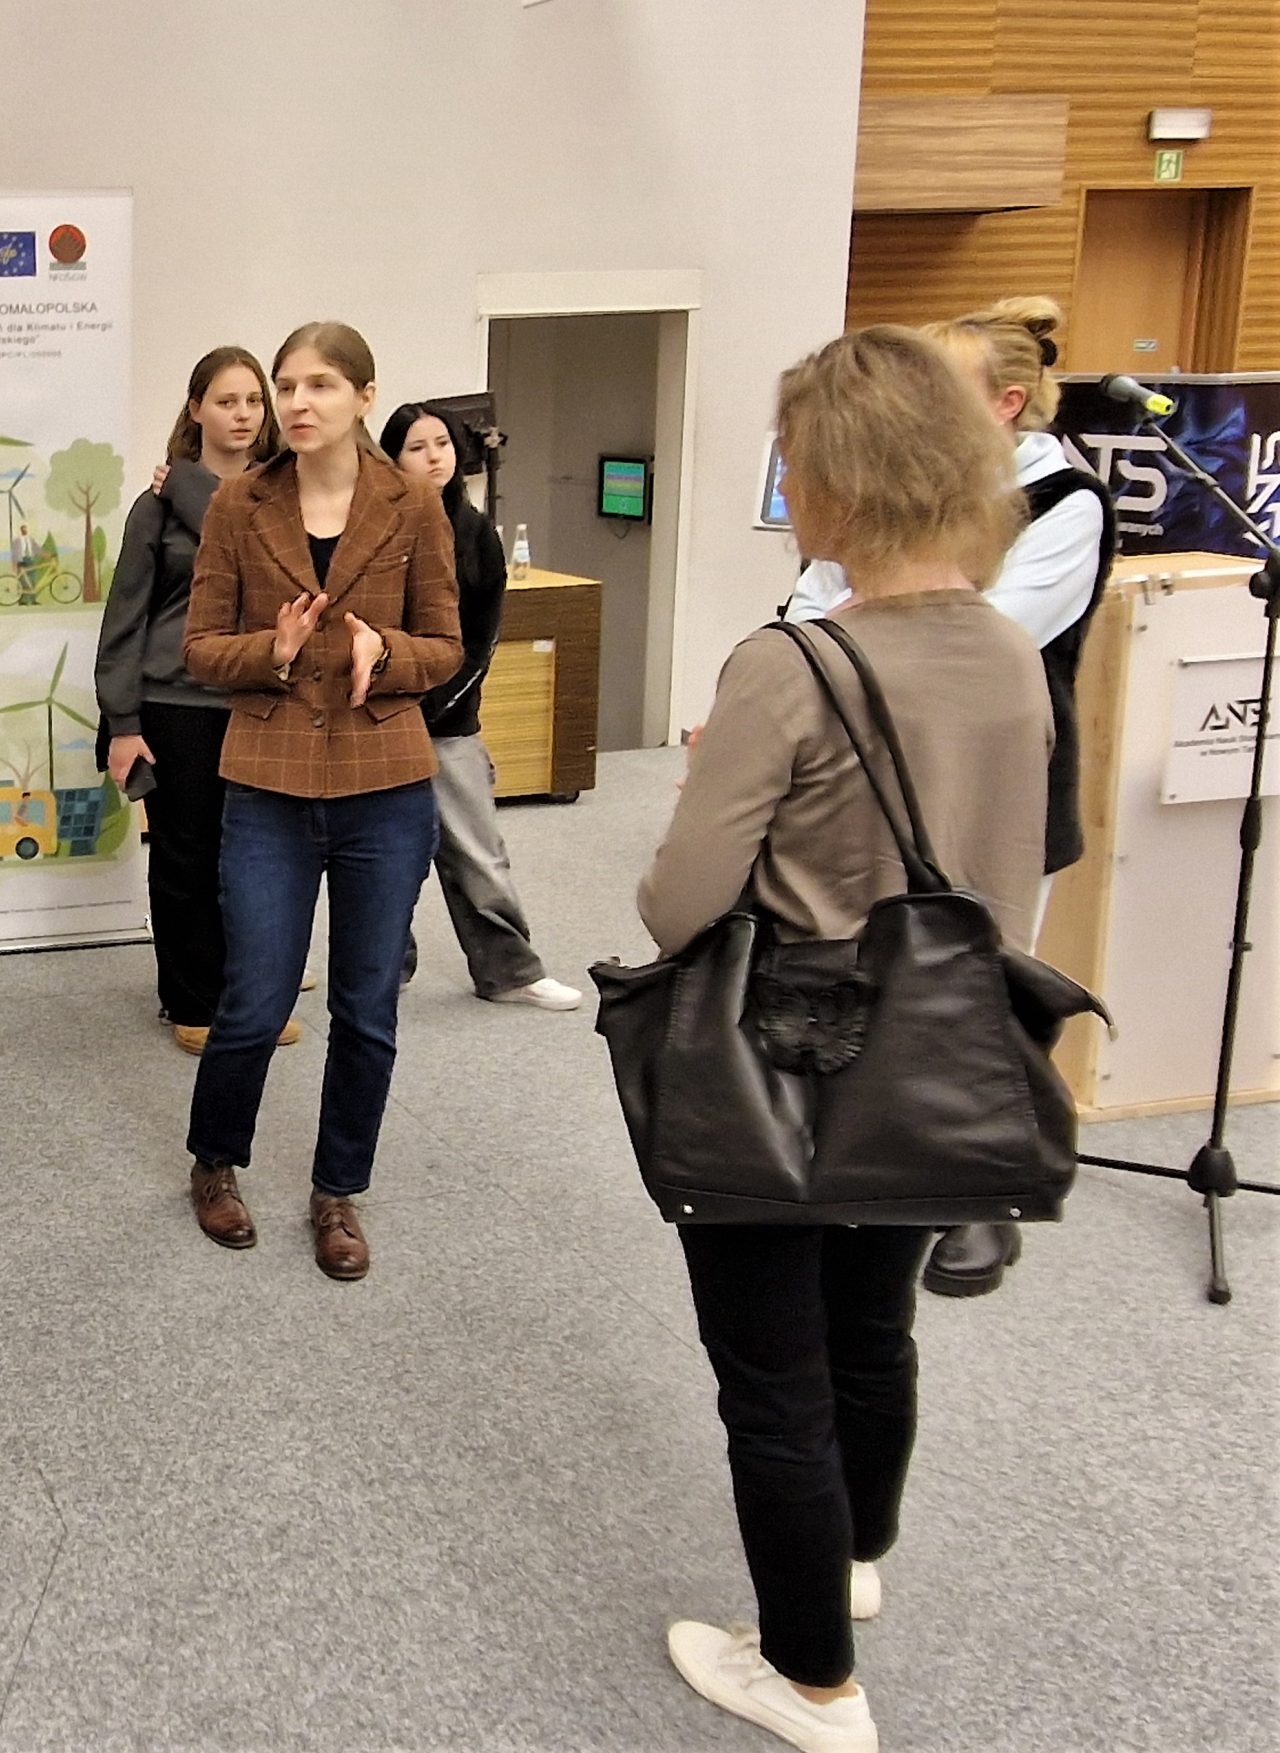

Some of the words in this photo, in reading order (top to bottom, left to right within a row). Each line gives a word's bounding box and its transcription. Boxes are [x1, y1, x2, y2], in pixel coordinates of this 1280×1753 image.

[6, 323, 23, 333] dla
[26, 322, 67, 332] Klimatu
[76, 321, 114, 333] Energii
